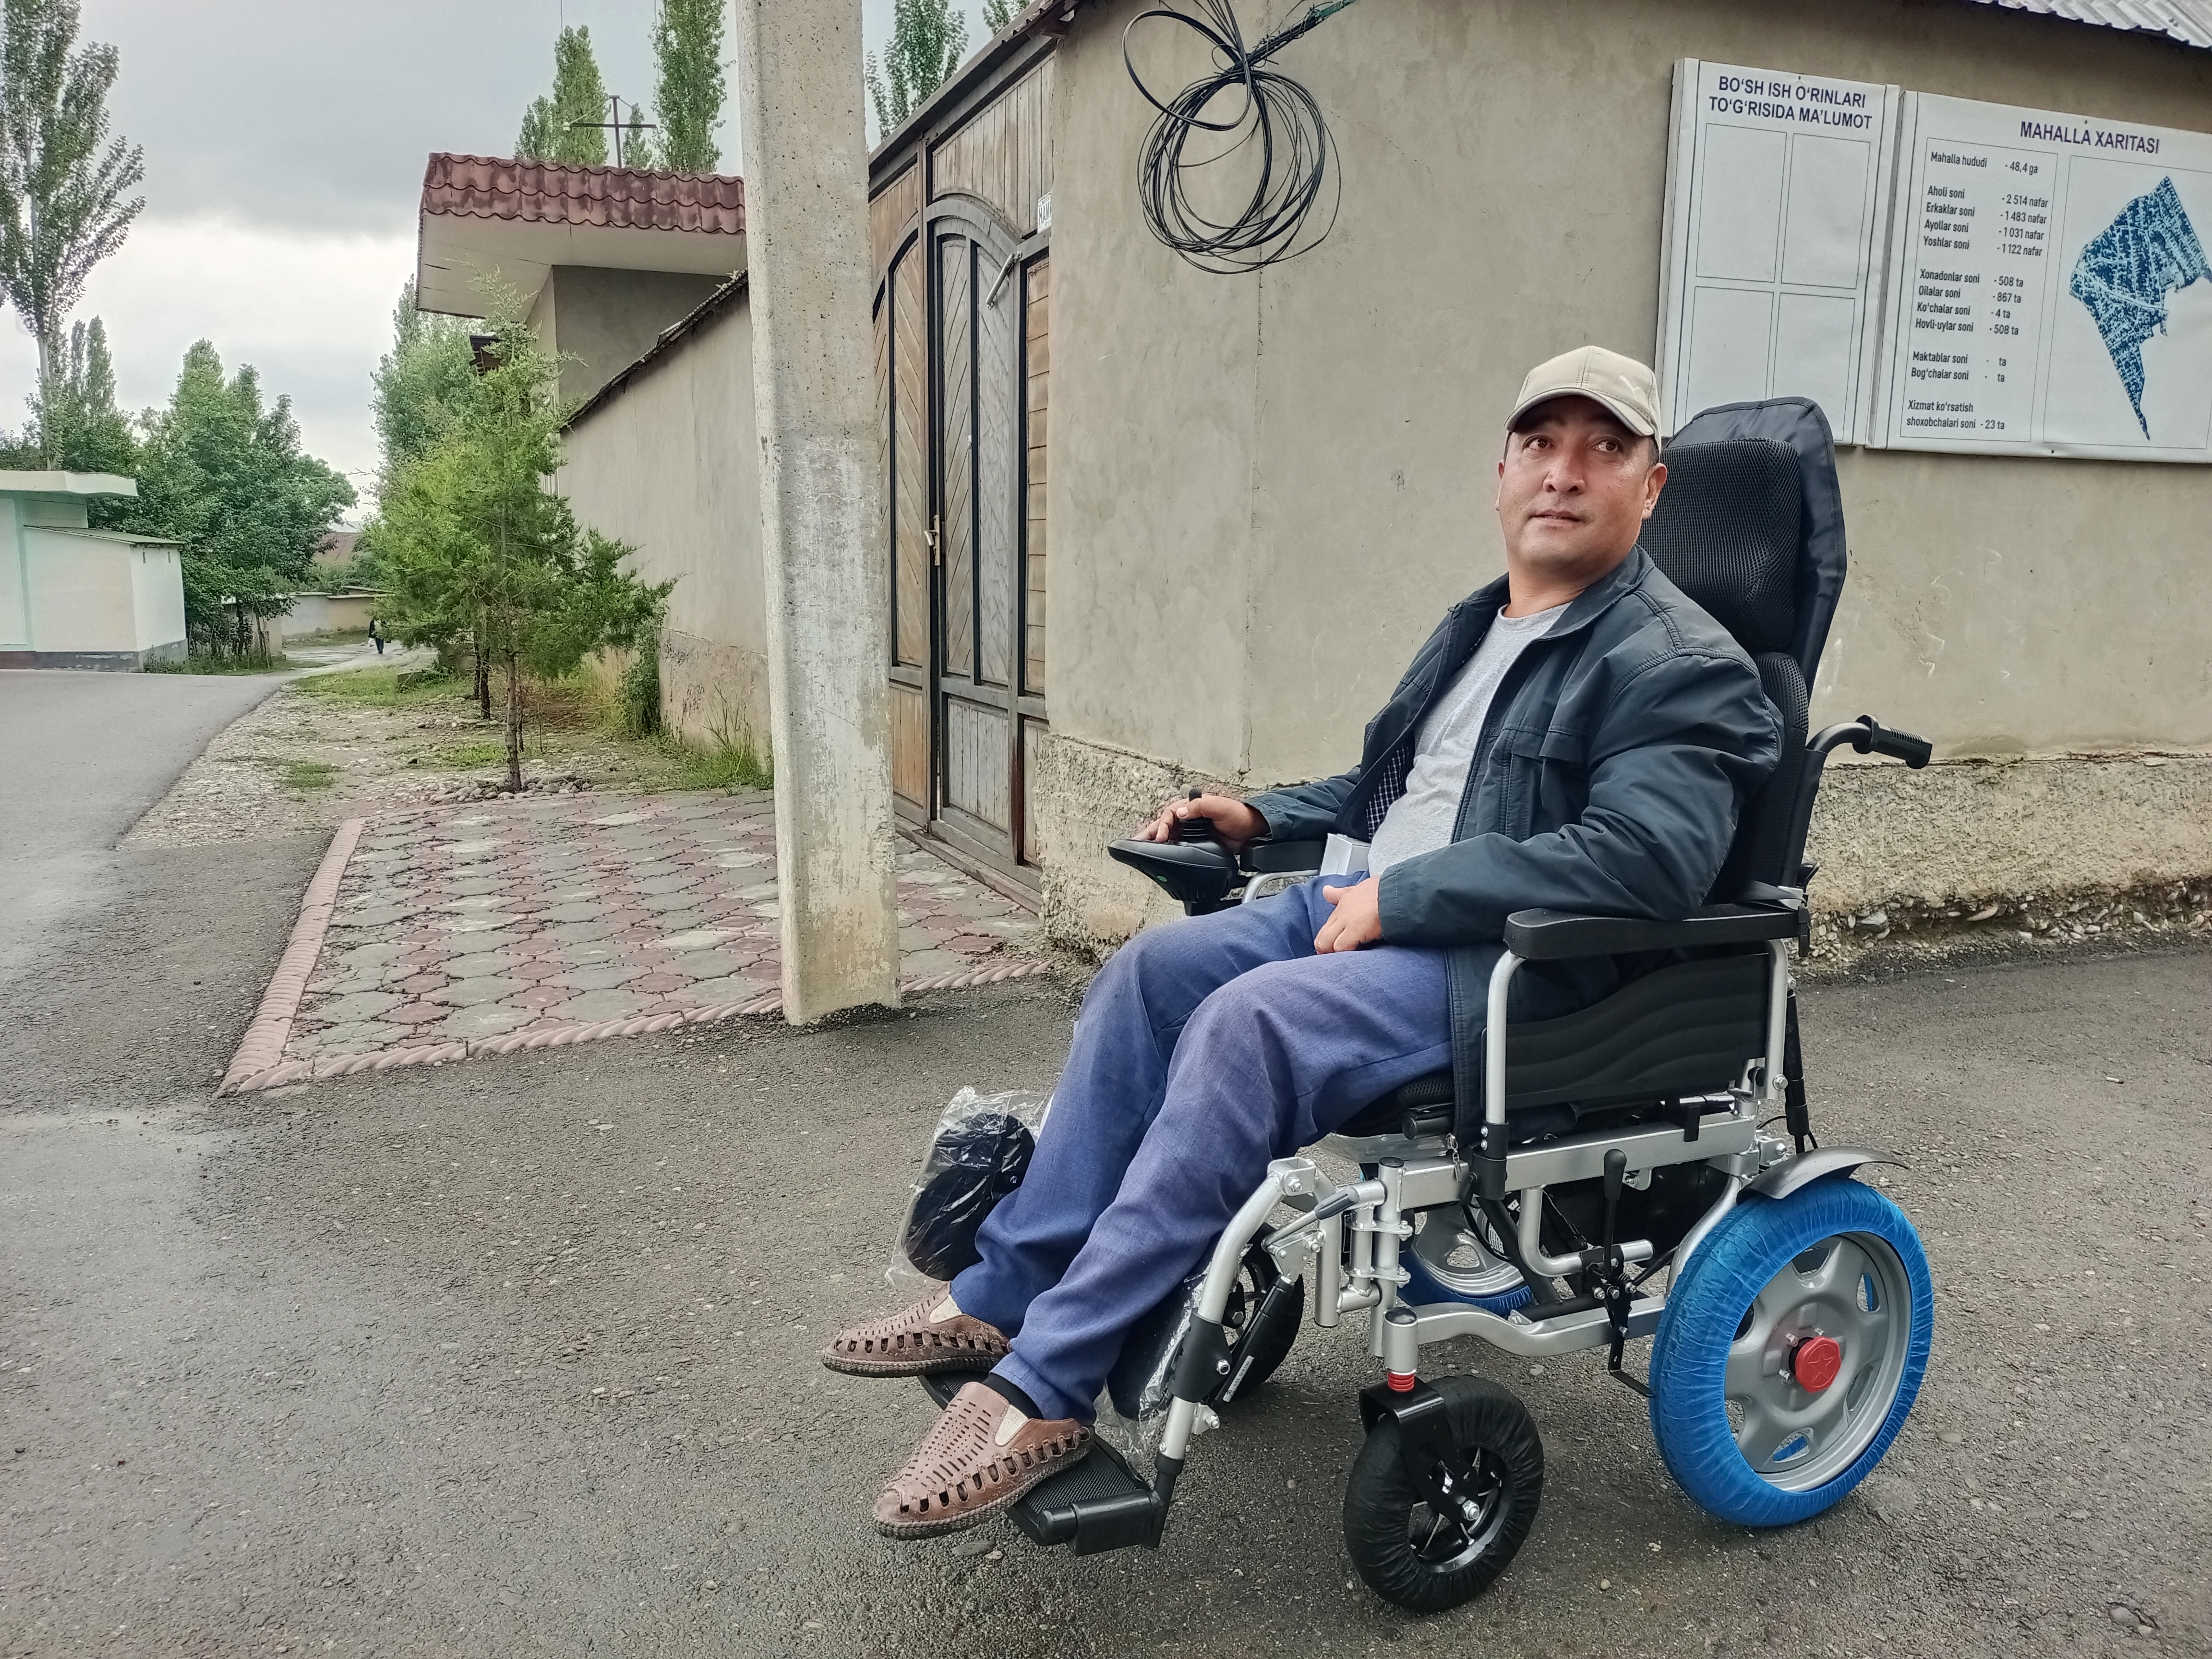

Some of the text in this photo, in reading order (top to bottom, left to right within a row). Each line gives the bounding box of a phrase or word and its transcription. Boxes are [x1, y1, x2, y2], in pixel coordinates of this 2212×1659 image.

[1768, 82, 1791, 98] ISH
[2020, 121, 2160, 154] MAHALLA XARITASI
[1931, 151, 1960, 164] Mahalla
[1962, 155, 1987, 168] hududi
[2029, 165, 2038, 176] ga
[1927, 185, 1948, 197] Aholi
[1949, 189, 1965, 199] soni
[2029, 197, 2048, 208] nafar
[1926, 202, 1958, 215] Erkaklar
[1959, 207, 1975, 216] soni
[2028, 214, 2047, 224] nafar
[1924, 219, 1951, 232] Ayollar
[1953, 223, 1969, 232] soni
[2025, 230, 2044, 240] nafar
[1923, 236, 1952, 248] Yoshlar
[1954, 240, 1970, 250] soni
[2023, 246, 2043, 256] nafar
[1920, 269, 1963, 282] Xonadonlar
[1964, 274, 1980, 283] soni
[1998, 276, 2014, 286] 508
[2016, 278, 2023, 287] ta
[1919, 285, 1943, 297] Oilalar
[1945, 289, 1960, 298] soni
[1997, 292, 2012, 302] 867
[2014, 294, 2021, 303] ta
[1955, 306, 1970, 315] soni
[1996, 308, 2001, 318] 4
[2003, 310, 2010, 318] ta
[1915, 318, 1957, 332] Hovli-uylar
[1958, 322, 1973, 332] soni
[1994, 324, 2009, 334] 508
[2011, 326, 2019, 335] ta
[1913, 351, 1951, 362] Maktablar
[1952, 354, 1968, 364] soni
[1999, 358, 2007, 366] ta
[1953, 371, 1969, 380] soni
[1997, 373, 2005, 382] ta
[1908, 400, 1935, 410] Xizmat
[1907, 416, 1959, 428] shoxobchalari
[1960, 419, 1976, 428] soni
[1985, 420, 1995, 429] 23
[1997, 421, 2005, 430] ta
[1239, 1361, 1250, 1376] SPRING
